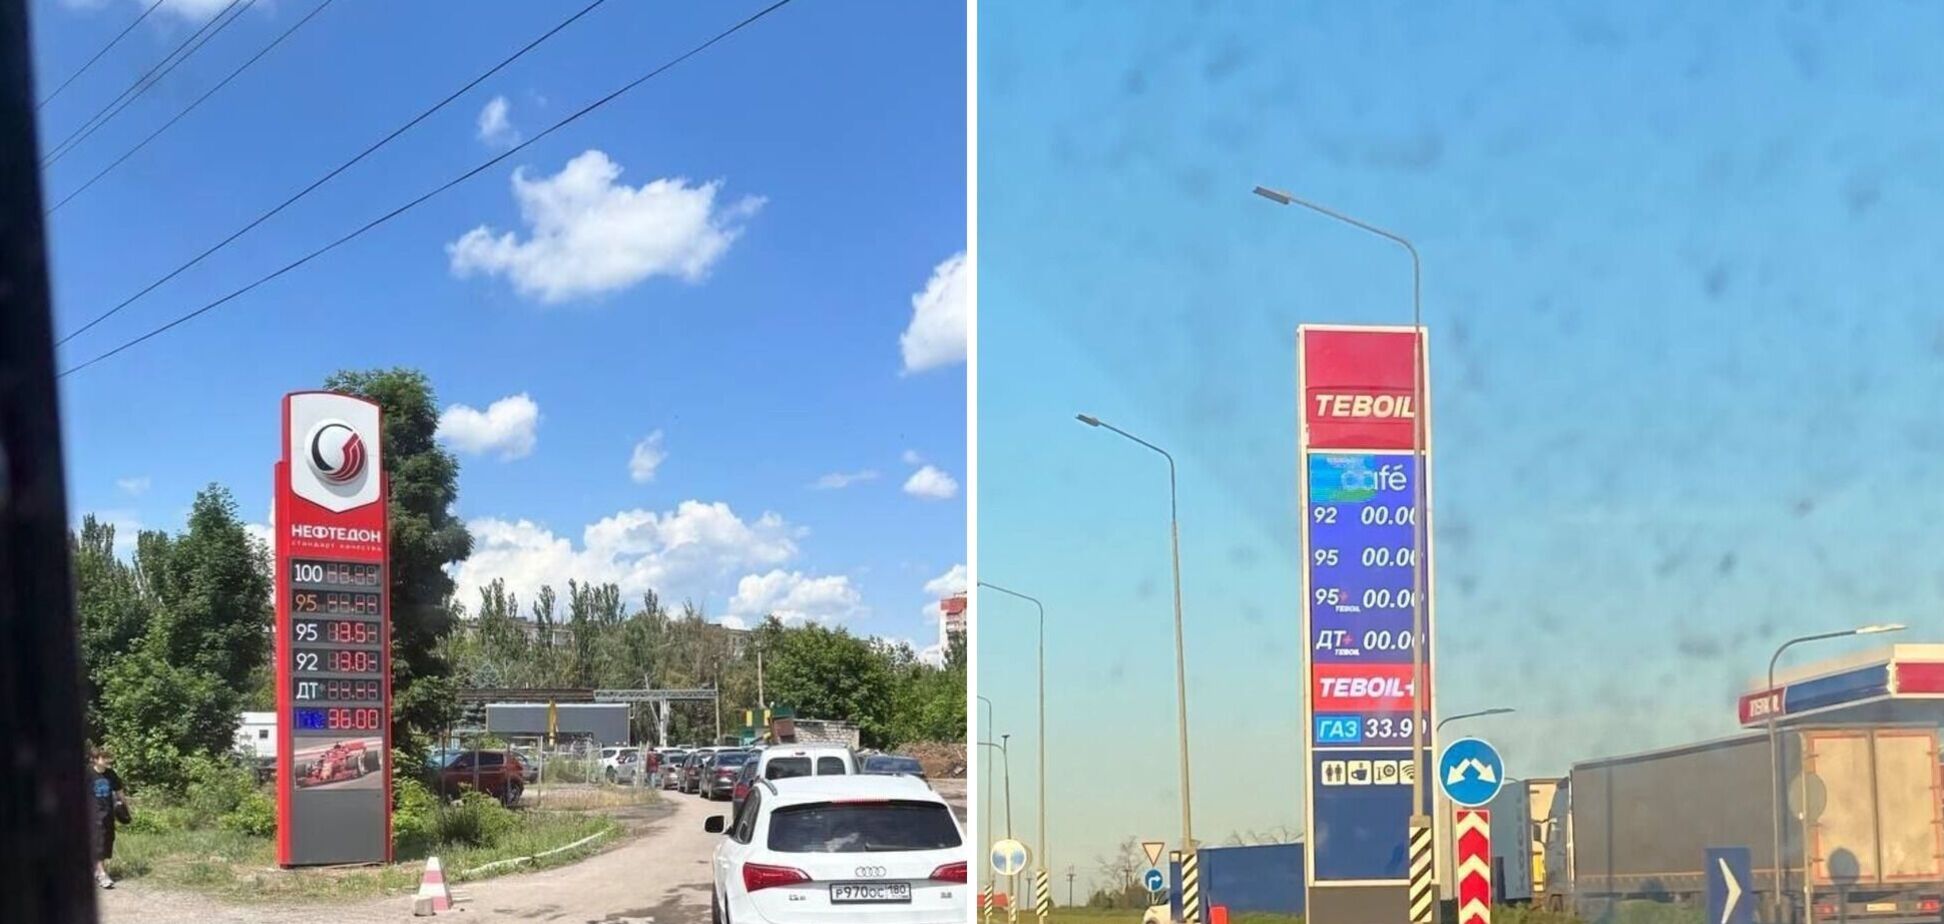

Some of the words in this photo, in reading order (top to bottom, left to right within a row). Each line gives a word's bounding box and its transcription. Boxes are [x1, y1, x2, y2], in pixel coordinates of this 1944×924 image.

[1315, 395, 1414, 418] TEBOIL
[1314, 507, 1338, 524] 92
[291, 524, 381, 543] НЕФТЕДОН
[1314, 549, 1338, 566] 95
[294, 564, 323, 582] 100
[296, 594, 317, 612] 95
[296, 623, 318, 641] 95
[296, 653, 318, 670] 92
[328, 709, 378, 729] 36.00
[1319, 720, 1358, 738] ГАЗ
[887, 885, 906, 895] 180
